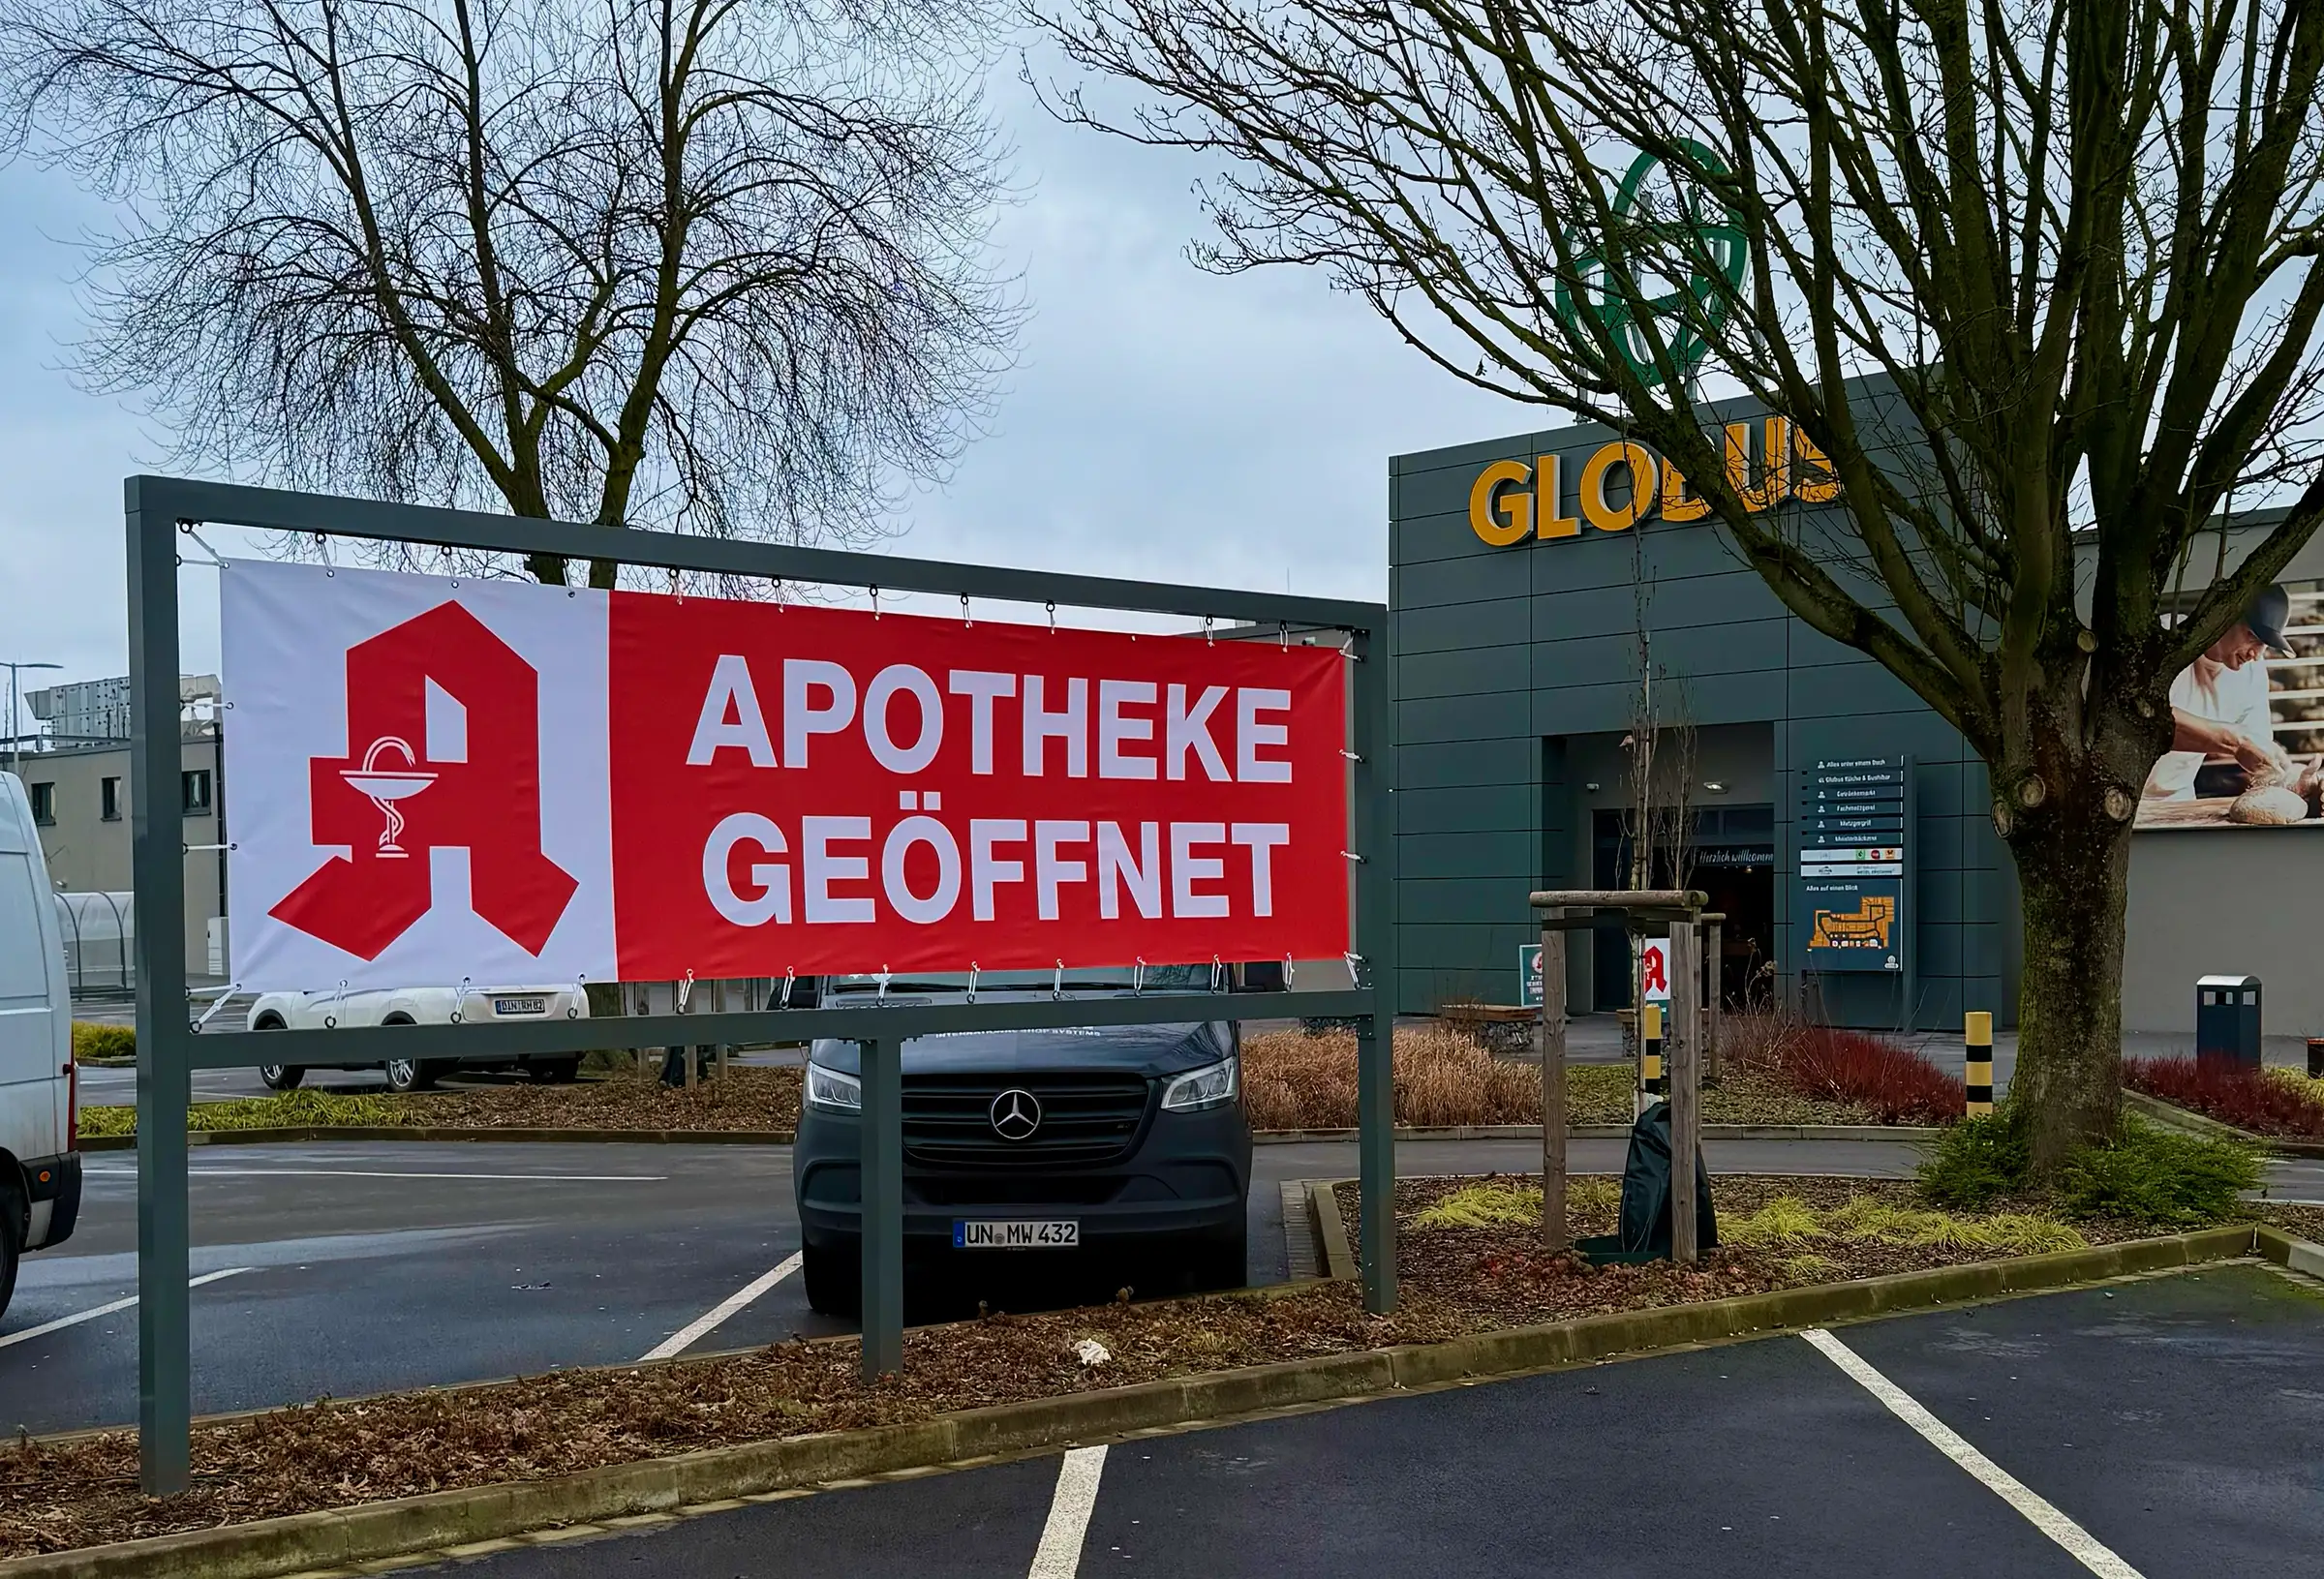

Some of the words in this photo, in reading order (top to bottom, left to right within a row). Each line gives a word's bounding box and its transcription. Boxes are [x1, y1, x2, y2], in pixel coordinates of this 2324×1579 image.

[685, 653, 1293, 784] APOTHEKE
[702, 790, 1291, 927] GEÖFFNET
[1699, 849, 1730, 864] Herzlich
[966, 1224, 994, 1244] UN
[1007, 1224, 1033, 1244] MW
[1037, 1223, 1077, 1244] 432
